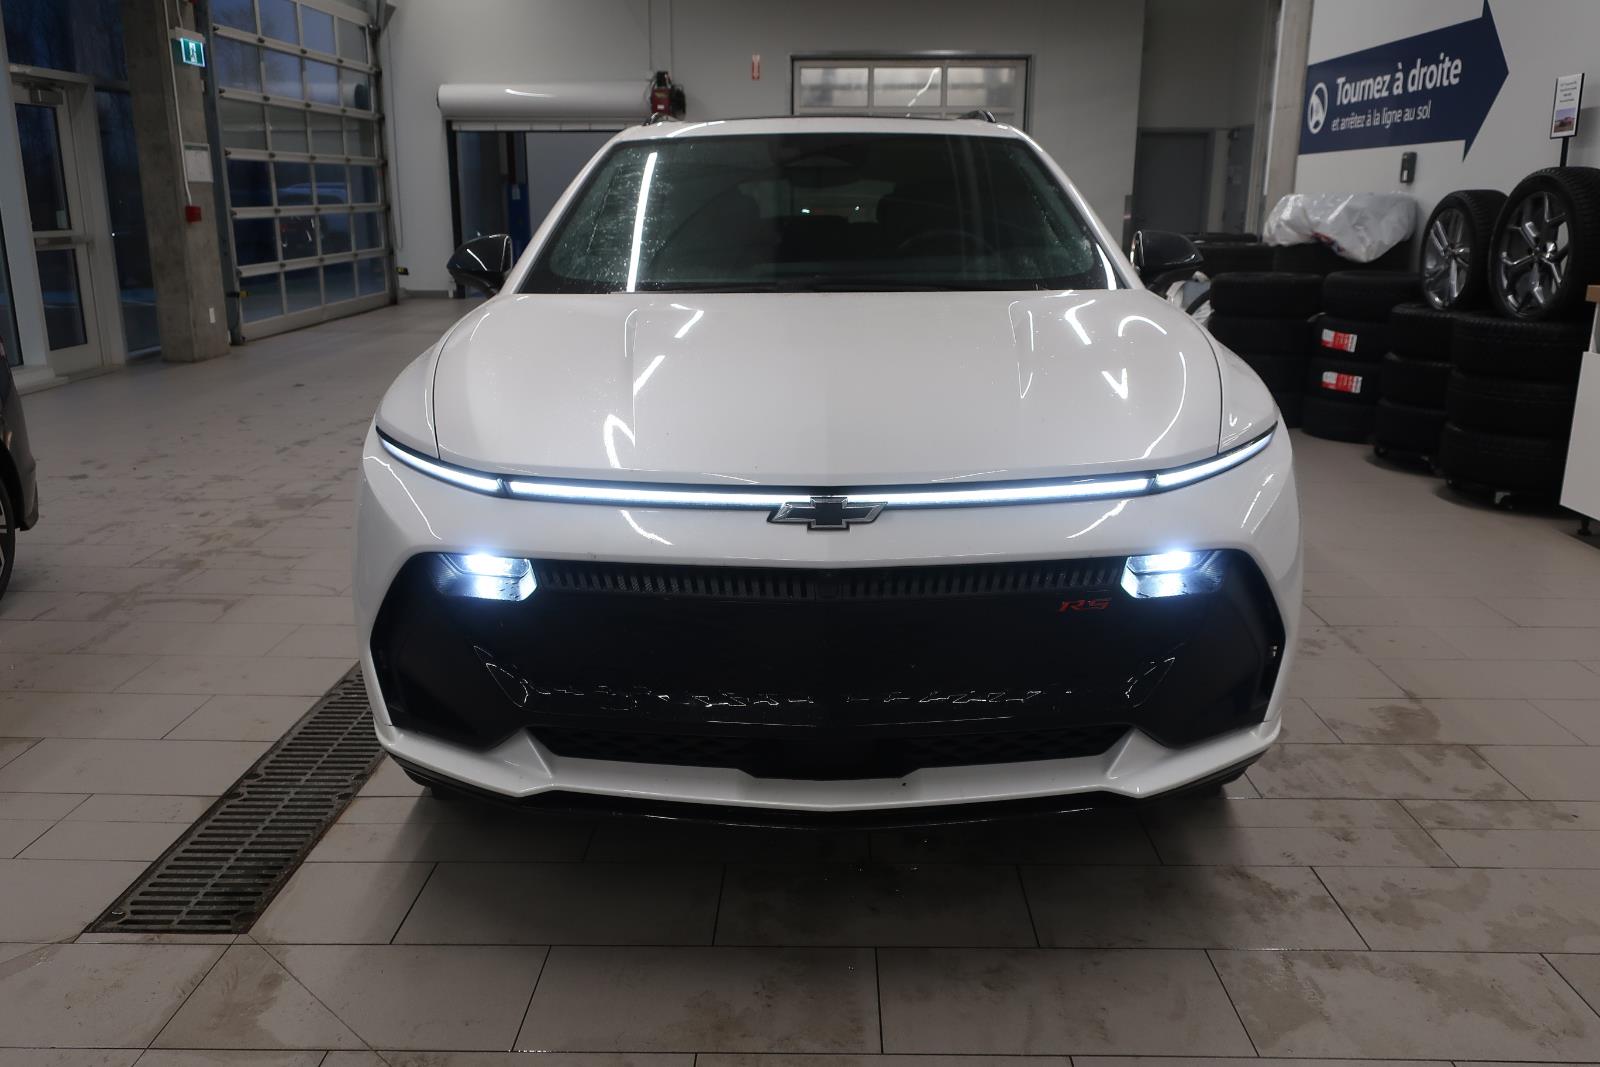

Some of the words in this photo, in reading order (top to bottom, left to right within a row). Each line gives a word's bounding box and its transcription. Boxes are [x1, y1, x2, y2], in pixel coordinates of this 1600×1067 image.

[1336, 74, 1391, 106] Tournez
[1393, 62, 1404, 95] à
[1407, 53, 1463, 92] droite
[1331, 118, 1340, 131] et
[1340, 111, 1365, 130] arrêtez
[1366, 110, 1373, 127] à
[1373, 109, 1381, 126] la
[1381, 107, 1402, 129] ligne
[1403, 108, 1416, 122] au
[1417, 100, 1431, 119] sol
[1058, 598, 1112, 613] RS
